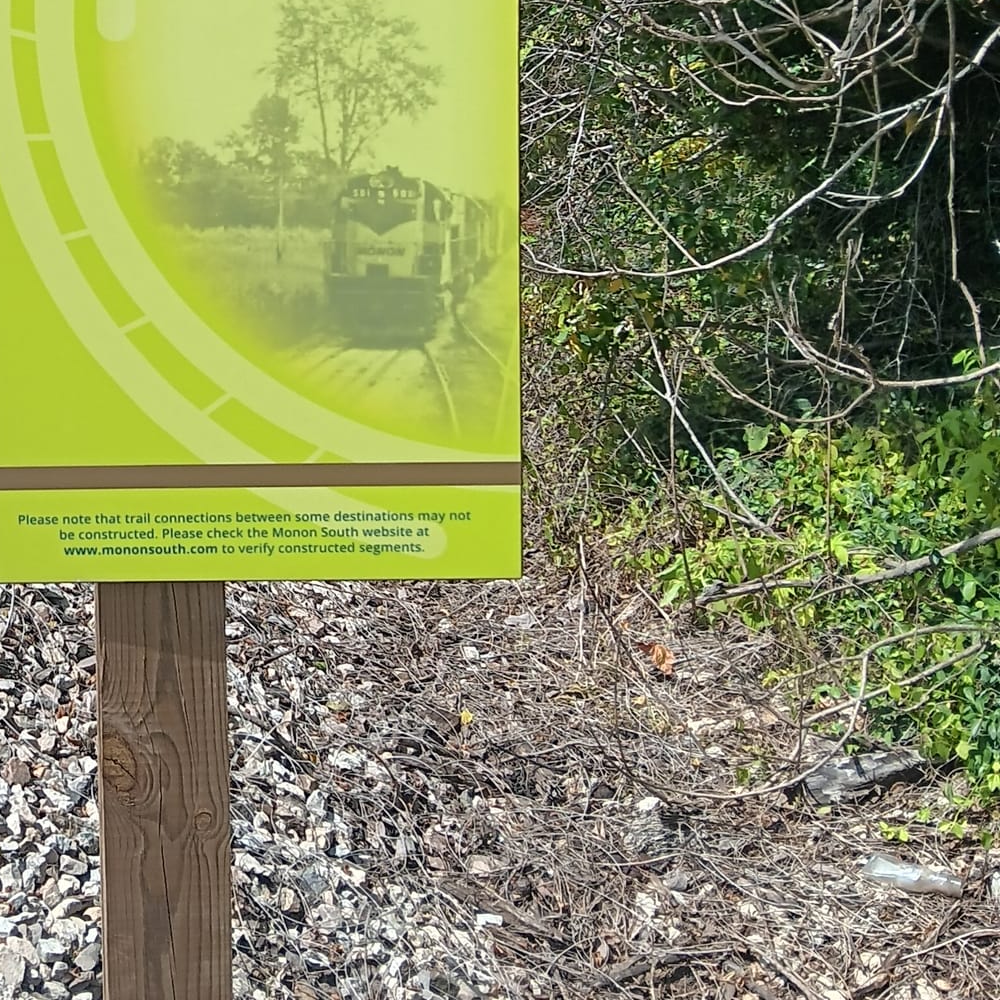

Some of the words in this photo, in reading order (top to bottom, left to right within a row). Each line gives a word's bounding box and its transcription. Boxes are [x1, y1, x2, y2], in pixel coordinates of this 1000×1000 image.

[18, 514, 58, 525] Please
[62, 515, 91, 525] note
[95, 513, 121, 524] that
[125, 513, 151, 524] trail
[154, 512, 232, 524] connections
[236, 511, 291, 523] between
[295, 513, 330, 522] some
[334, 510, 414, 522] destinations
[418, 512, 446, 524] may
[450, 511, 471, 521] not
[59, 529, 75, 540] be
[78, 528, 158, 540] constructed.
[162, 528, 203, 539] Please
[206, 527, 243, 538] check
[247, 527, 268, 538] the
[272, 527, 317, 538] Monon
[321, 526, 358, 537] South
[362, 526, 413, 537] website
[416, 527, 429, 537] at
[64, 543, 218, 555] www.mononsouth.com
[222, 545, 235, 554] to
[238, 542, 275, 556] verify
[278, 542, 355, 553] constructed
[359, 543, 425, 555] segments.
